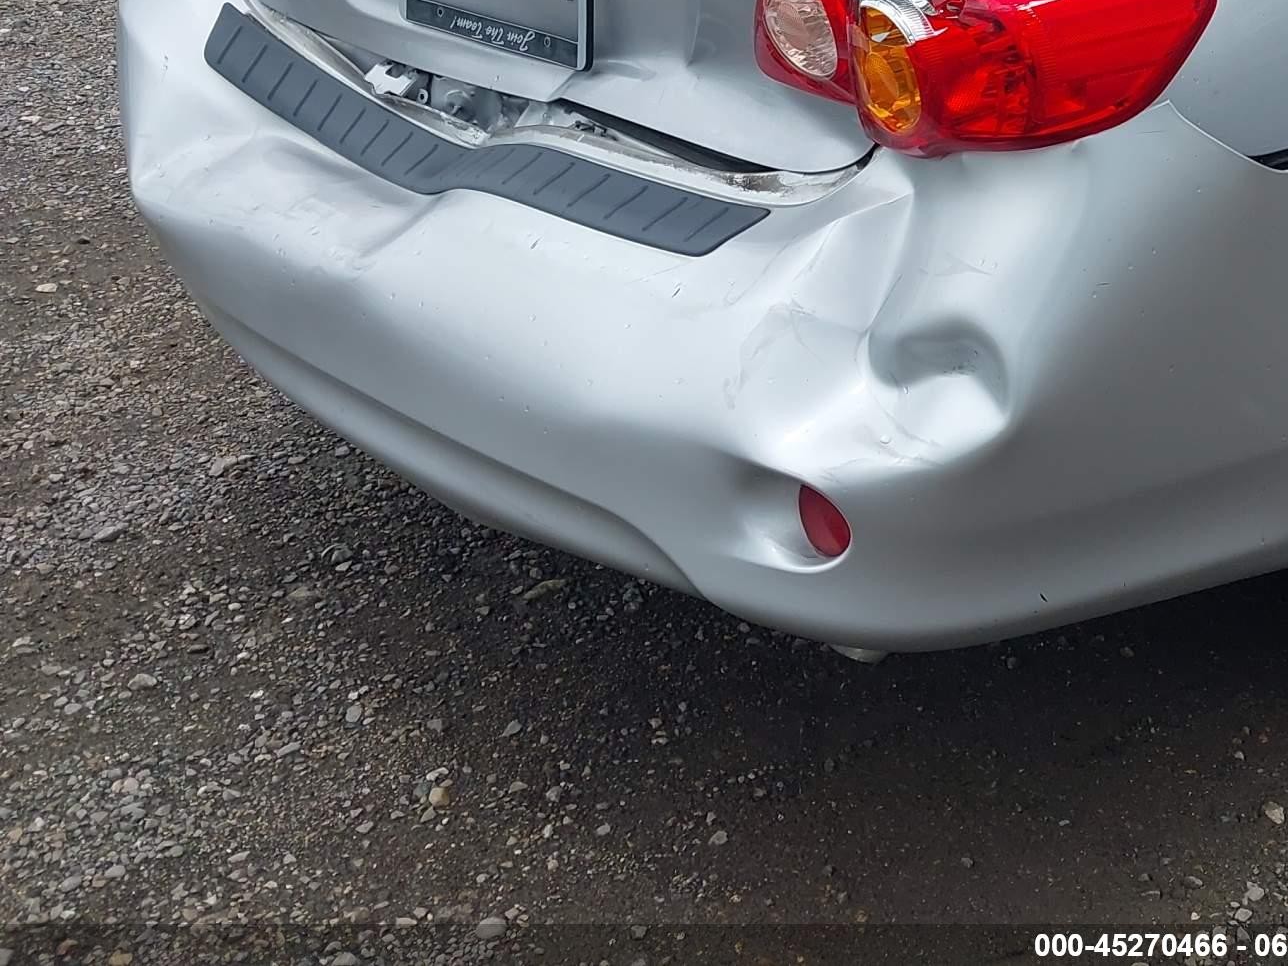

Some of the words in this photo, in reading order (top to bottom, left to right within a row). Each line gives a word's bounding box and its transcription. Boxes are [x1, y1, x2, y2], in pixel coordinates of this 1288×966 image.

[449, 16, 484, 42] Team!
[485, 25, 505, 45] The
[506, 29, 536, 52] Join
